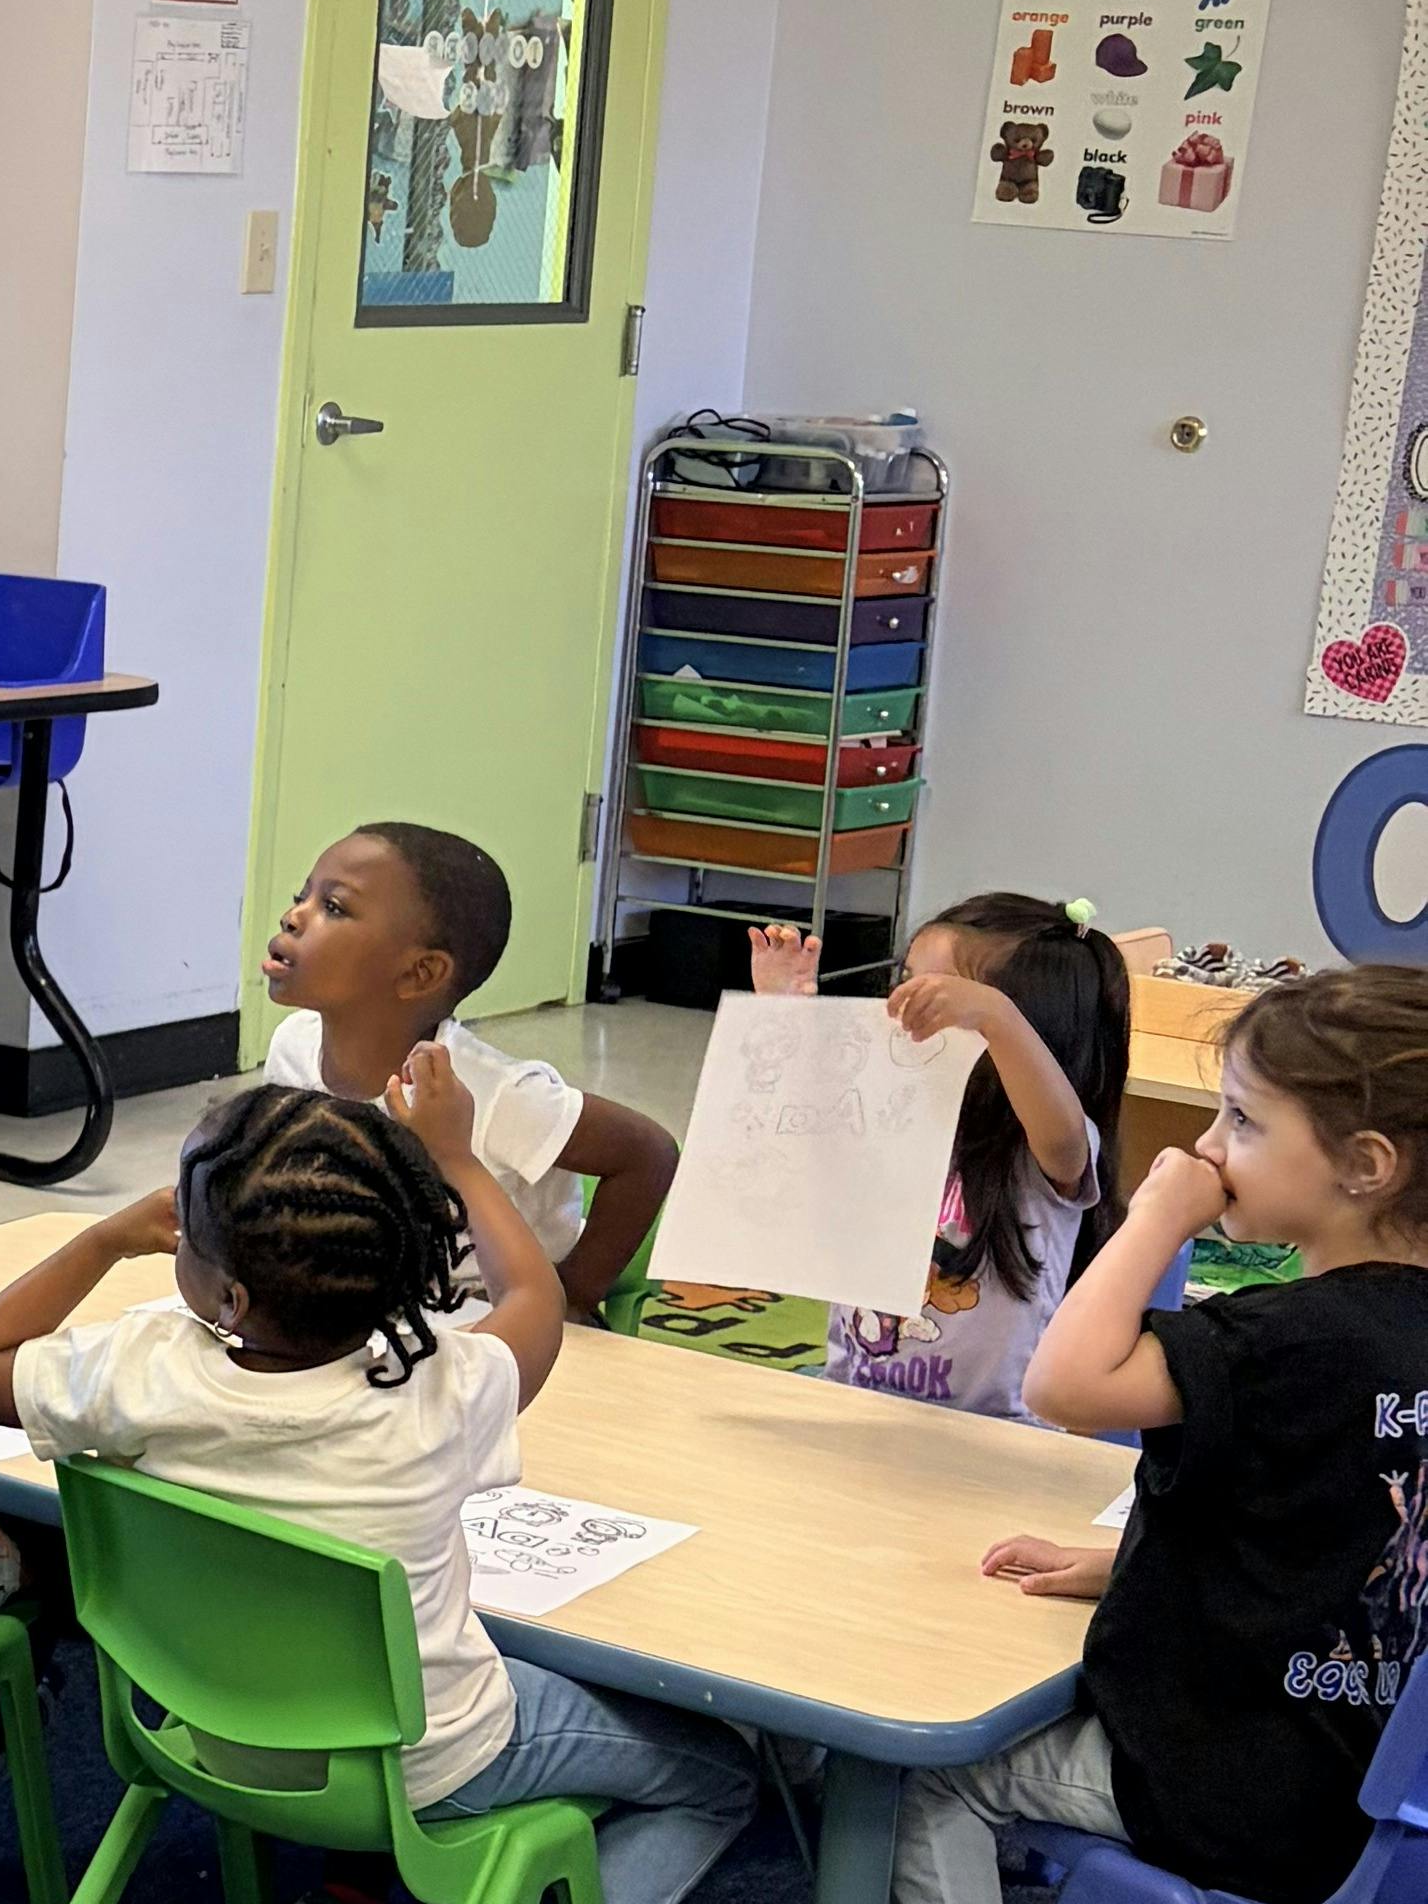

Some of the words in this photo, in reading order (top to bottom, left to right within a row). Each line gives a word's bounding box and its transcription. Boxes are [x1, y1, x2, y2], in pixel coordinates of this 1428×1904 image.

[1011, 9, 1070, 27] orange
[1099, 11, 1153, 29] purple
[1194, 16, 1245, 33] green
[1003, 101, 1055, 118] brown
[1185, 110, 1223, 128] pink
[1083, 149, 1128, 165] black
[1333, 647, 1365, 673] YOU
[1366, 637, 1396, 660] ARE
